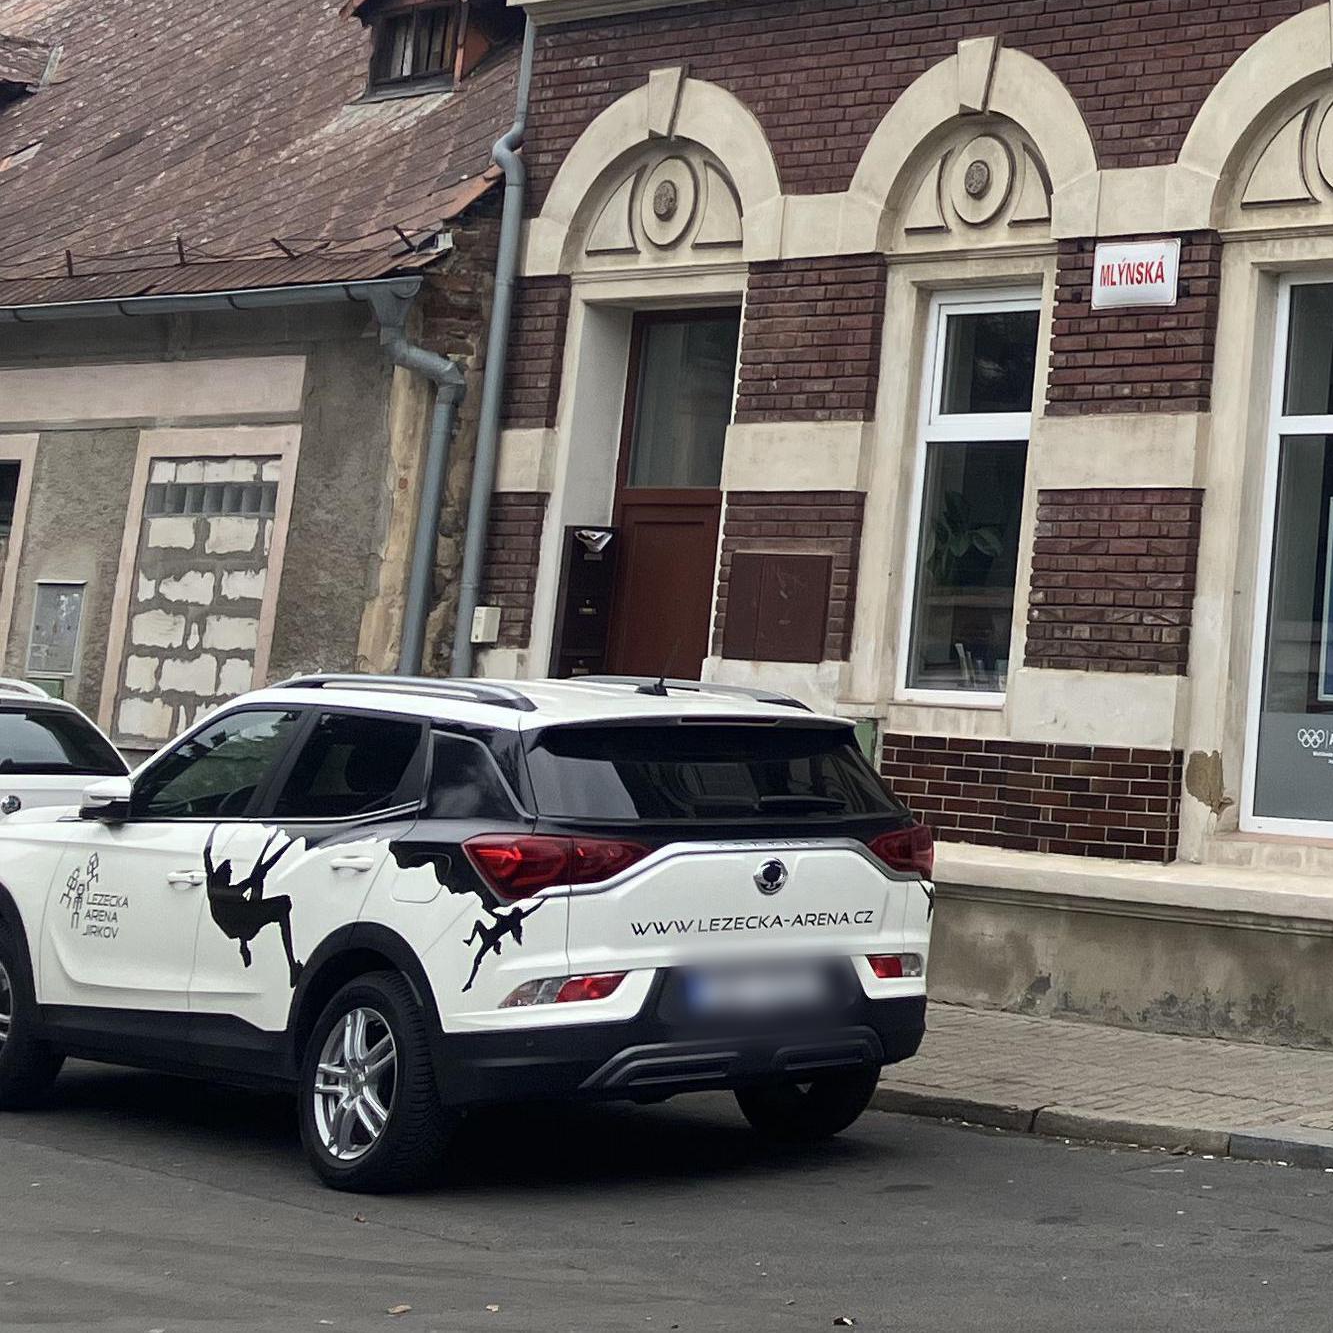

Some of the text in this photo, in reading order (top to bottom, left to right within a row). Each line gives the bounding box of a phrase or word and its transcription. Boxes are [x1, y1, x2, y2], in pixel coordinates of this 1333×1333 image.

[1100, 254, 1165, 287] MLÝNSKÁ
[86, 893, 129, 908] LEZECKA
[84, 909, 118, 923] ARENA
[631, 910, 874, 936] WWW.LEZECKA-ARENA.CZ
[82, 925, 119, 939] JIRKOV
